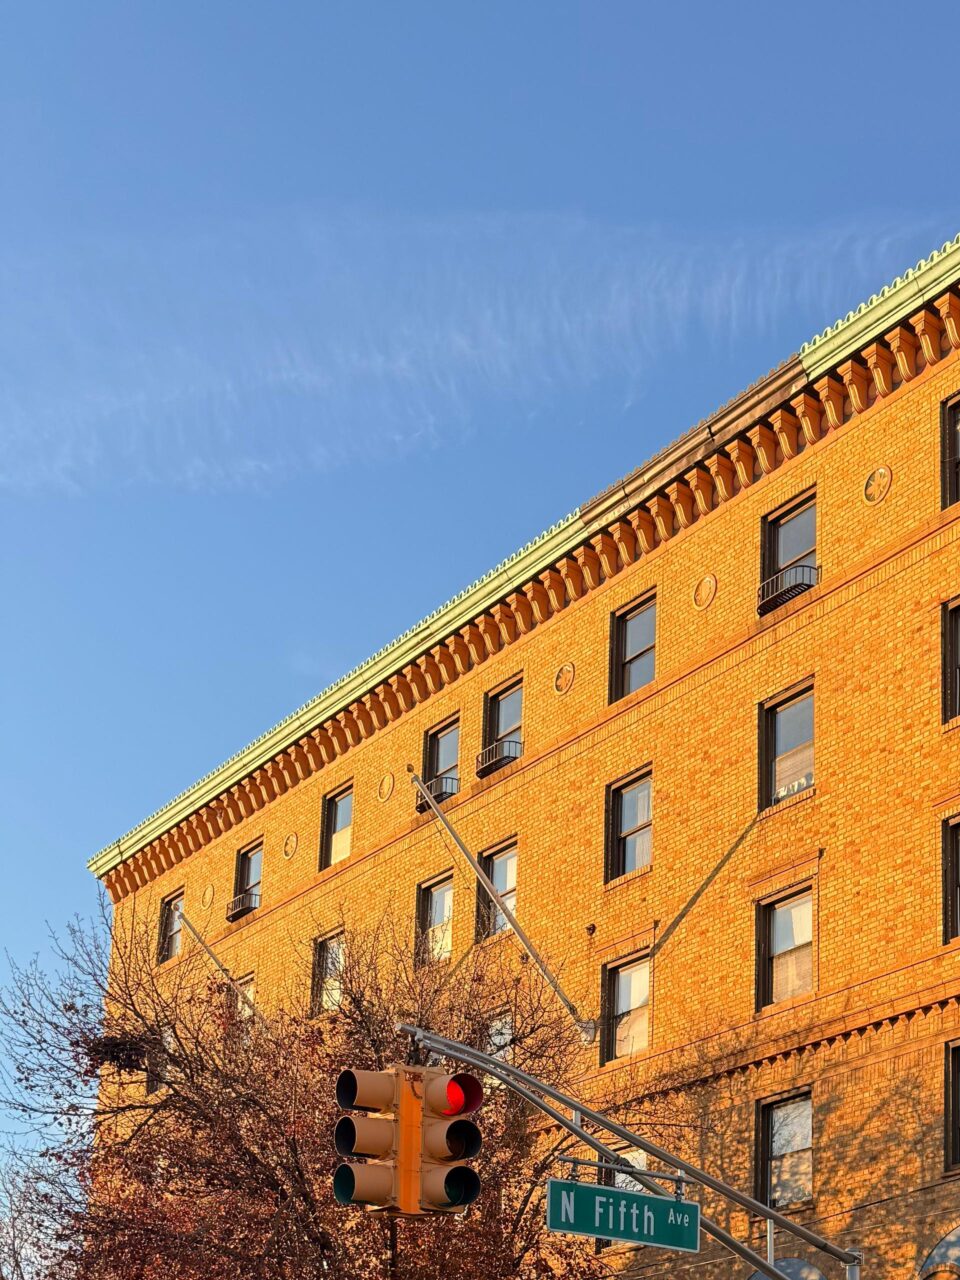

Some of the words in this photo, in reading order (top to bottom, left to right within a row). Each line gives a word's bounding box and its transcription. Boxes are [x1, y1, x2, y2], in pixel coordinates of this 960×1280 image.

[561, 1190, 575, 1223] N
[594, 1195, 655, 1236] Fifth
[667, 1208, 690, 1227] Ave
